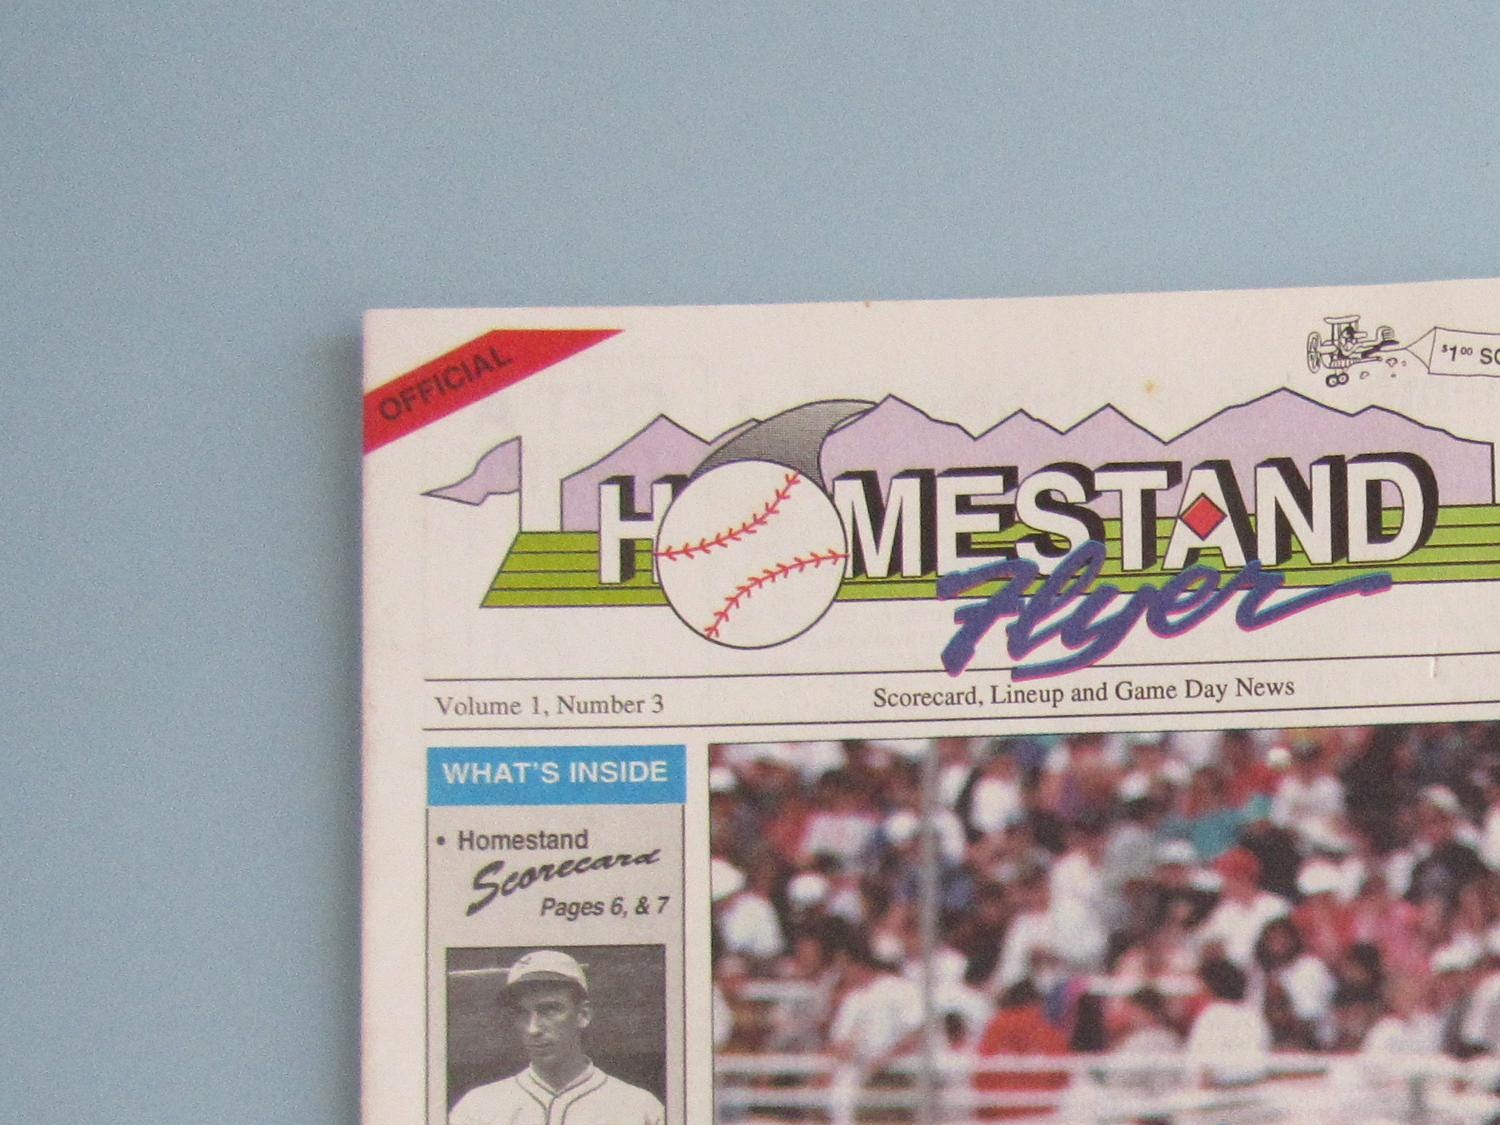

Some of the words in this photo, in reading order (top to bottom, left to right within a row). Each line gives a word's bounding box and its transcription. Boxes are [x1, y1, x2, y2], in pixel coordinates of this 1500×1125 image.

[377, 346, 513, 422] OFFICIAL
[935, 539, 1392, 681] Flyer
[435, 696, 524, 715] Volume
[531, 695, 550, 717] 1,
[557, 693, 645, 715] Number
[652, 693, 664, 714] 3
[873, 685, 984, 708] Scorecard,
[990, 682, 1064, 707] Lineup
[1070, 681, 1110, 701] and
[1115, 680, 1178, 701] Game
[1185, 678, 1228, 704] Day
[1237, 676, 1295, 697] News
[443, 762, 559, 784] WHAT'S
[570, 761, 668, 783] INSIDE
[459, 830, 589, 851] Homestand
[466, 848, 661, 916] Scorecard
[541, 897, 604, 921] Pages
[610, 897, 628, 919] 6,
[636, 897, 651, 915] &
[658, 896, 669, 914] 7
